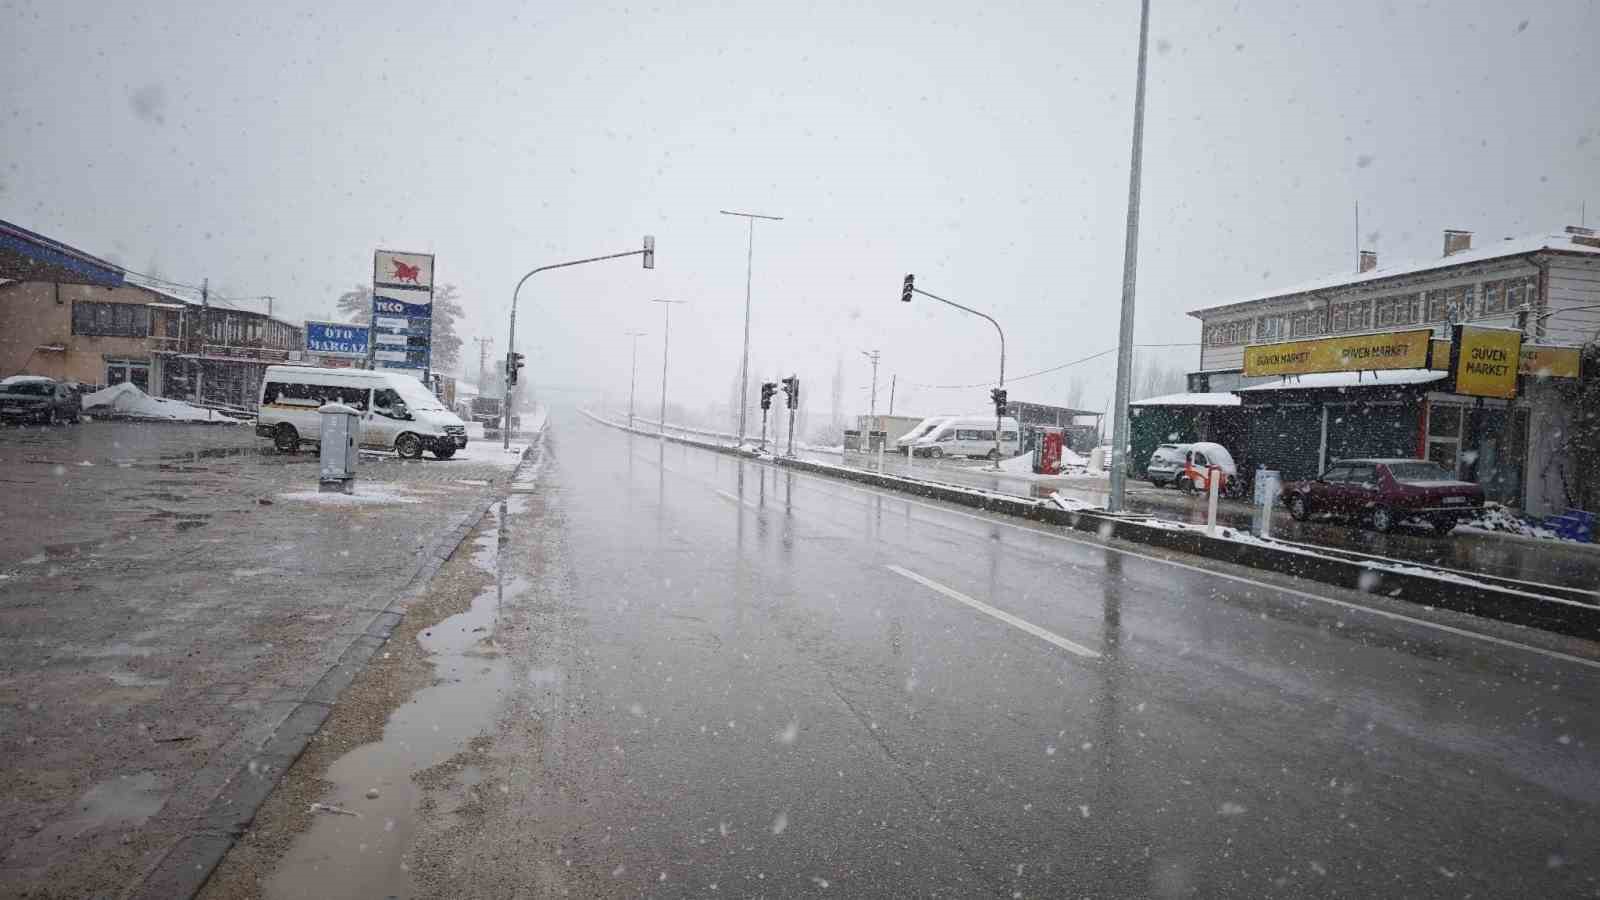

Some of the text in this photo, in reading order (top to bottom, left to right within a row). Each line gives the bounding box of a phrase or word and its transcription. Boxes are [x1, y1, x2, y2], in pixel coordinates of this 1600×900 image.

[376, 302, 404, 313] TECO
[324, 327, 353, 339] OTO
[1372, 343, 1409, 357] MARKET
[1281, 351, 1311, 364] MARKET
[1465, 361, 1510, 376] MARKET
